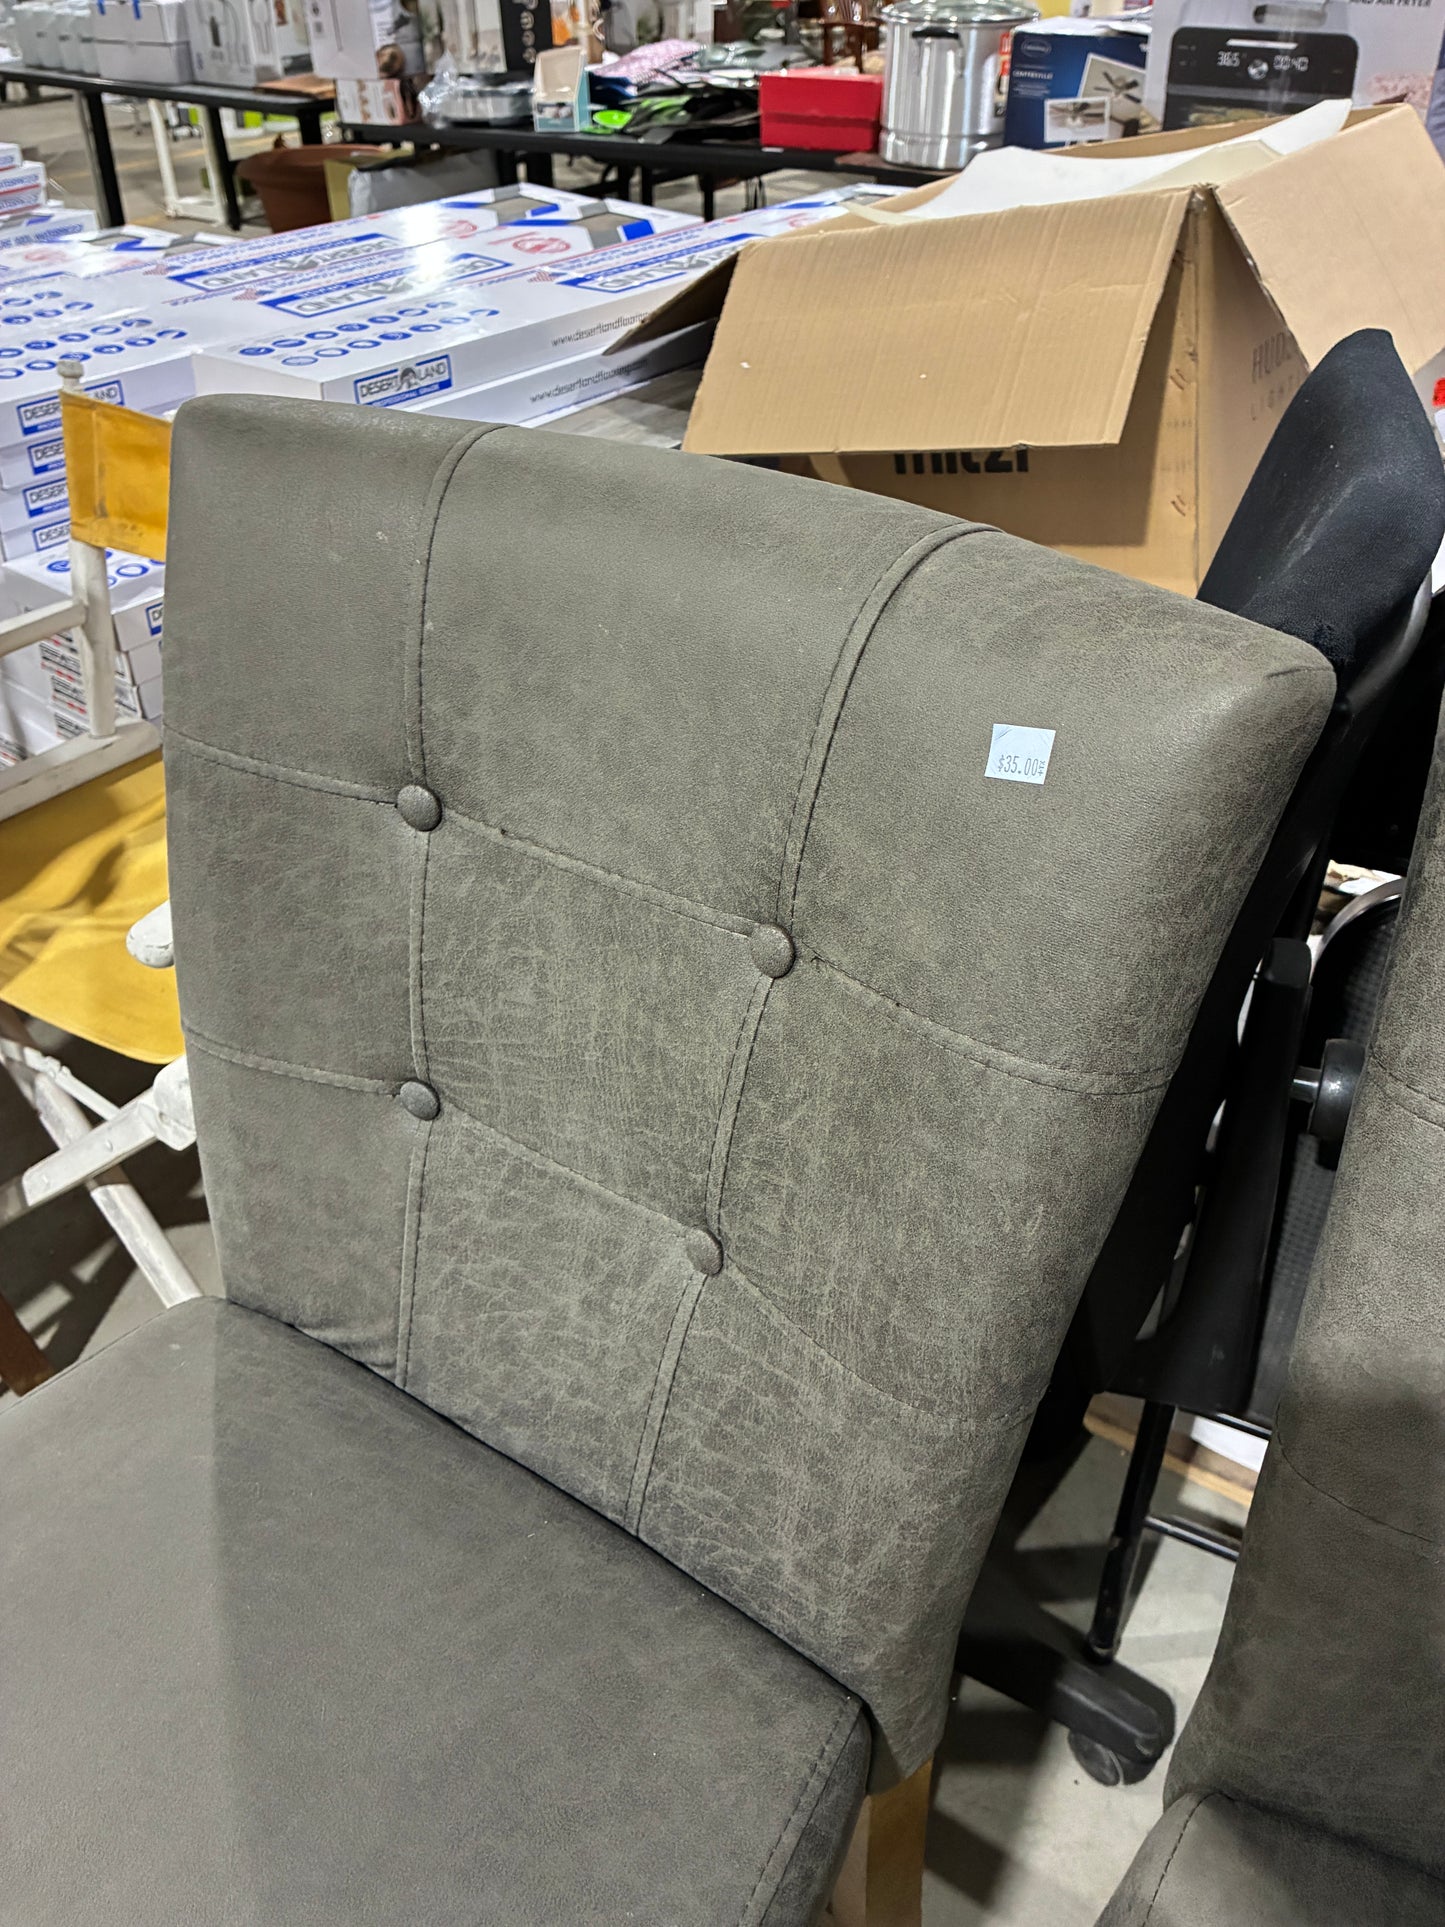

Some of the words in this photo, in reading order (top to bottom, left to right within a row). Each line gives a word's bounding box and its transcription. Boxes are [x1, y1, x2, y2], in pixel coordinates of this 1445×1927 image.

[360, 375, 400, 398] DESERT
[418, 361, 447, 382] LAND
[23, 401, 62, 422] DESER
[29, 482, 67, 504] DESER
[998, 754, 1039, 777] $35.00
